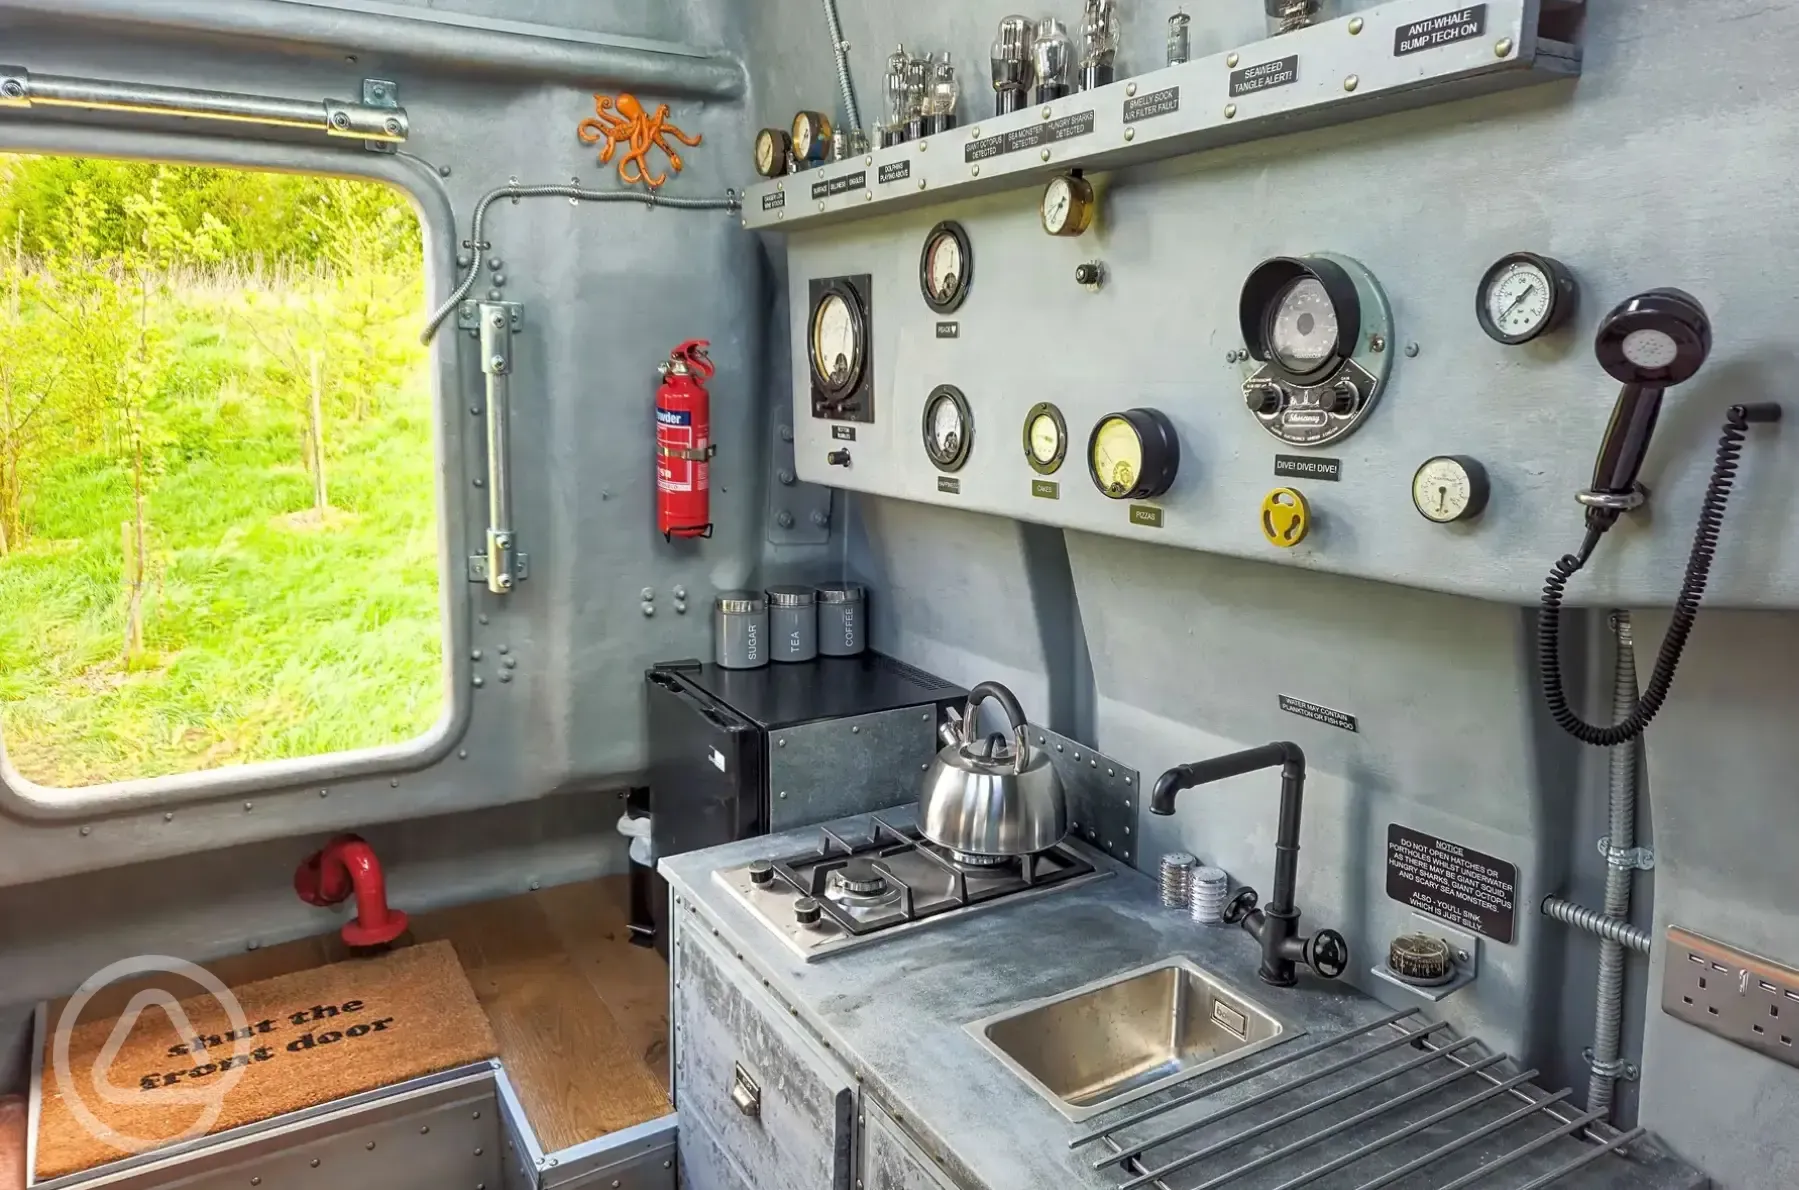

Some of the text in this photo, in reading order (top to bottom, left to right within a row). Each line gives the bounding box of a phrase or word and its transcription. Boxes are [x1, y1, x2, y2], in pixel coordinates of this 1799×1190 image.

[1408, 9, 1472, 36] ANTI-WHALE
[1400, 22, 1477, 52] BUMP TECH ON
[1235, 70, 1292, 93] TANGLE ALERT!
[1245, 61, 1283, 79] SEAWEED
[1124, 99, 1178, 121] AIR FILTER FAULT
[1130, 89, 1173, 109] SMELLY SOCK
[1071, 112, 1094, 124] SHARKS
[1008, 125, 1042, 141] SEA MONSTER
[1012, 136, 1039, 150] DETECTED
[1056, 124, 1084, 139] DETECTED
[972, 147, 996, 160] DETECTED
[1277, 461, 1337, 474] DIVE! DIVE! DIVE!
[1136, 511, 1155, 520] PIZZAS
[845, 608, 854, 647] COFFEE
[748, 625, 756, 660] SUGAR
[791, 631, 800, 653] TEA
[1283, 703, 1313, 718] PLANKTON
[1314, 713, 1323, 721] OR
[1286, 698, 1348, 721] WATER MAY CONTAIN
[1401, 838, 1498, 879] DO NOT OPEN HATCHES OR
[1436, 840, 1464, 857] NOTICE
[1389, 842, 1513, 893] PORTHOLES WHILST UNDERWATER
[1394, 852, 1404, 861] AS
[1404, 856, 1428, 870] THERE
[1429, 864, 1445, 875] MAY
[1445, 870, 1456, 880] BE
[1457, 875, 1480, 888] GIANT
[1389, 858, 1418, 874] HUNGRY
[1452, 881, 1474, 894] GIANT
[1475, 890, 1512, 909] OCTOPUS
[1399, 870, 1414, 881] AND
[1415, 875, 1439, 890] SCARY
[1440, 885, 1456, 896] SEA
[1409, 897, 1434, 912] WHICH
[1435, 908, 1442, 916] IS
[1443, 912, 1462, 923] JUST
[1413, 891, 1432, 903] ALSO
[1437, 900, 1462, 915] YOU'LL
[168, 1000, 364, 1057] shut the
[140, 1017, 394, 1091] front door
